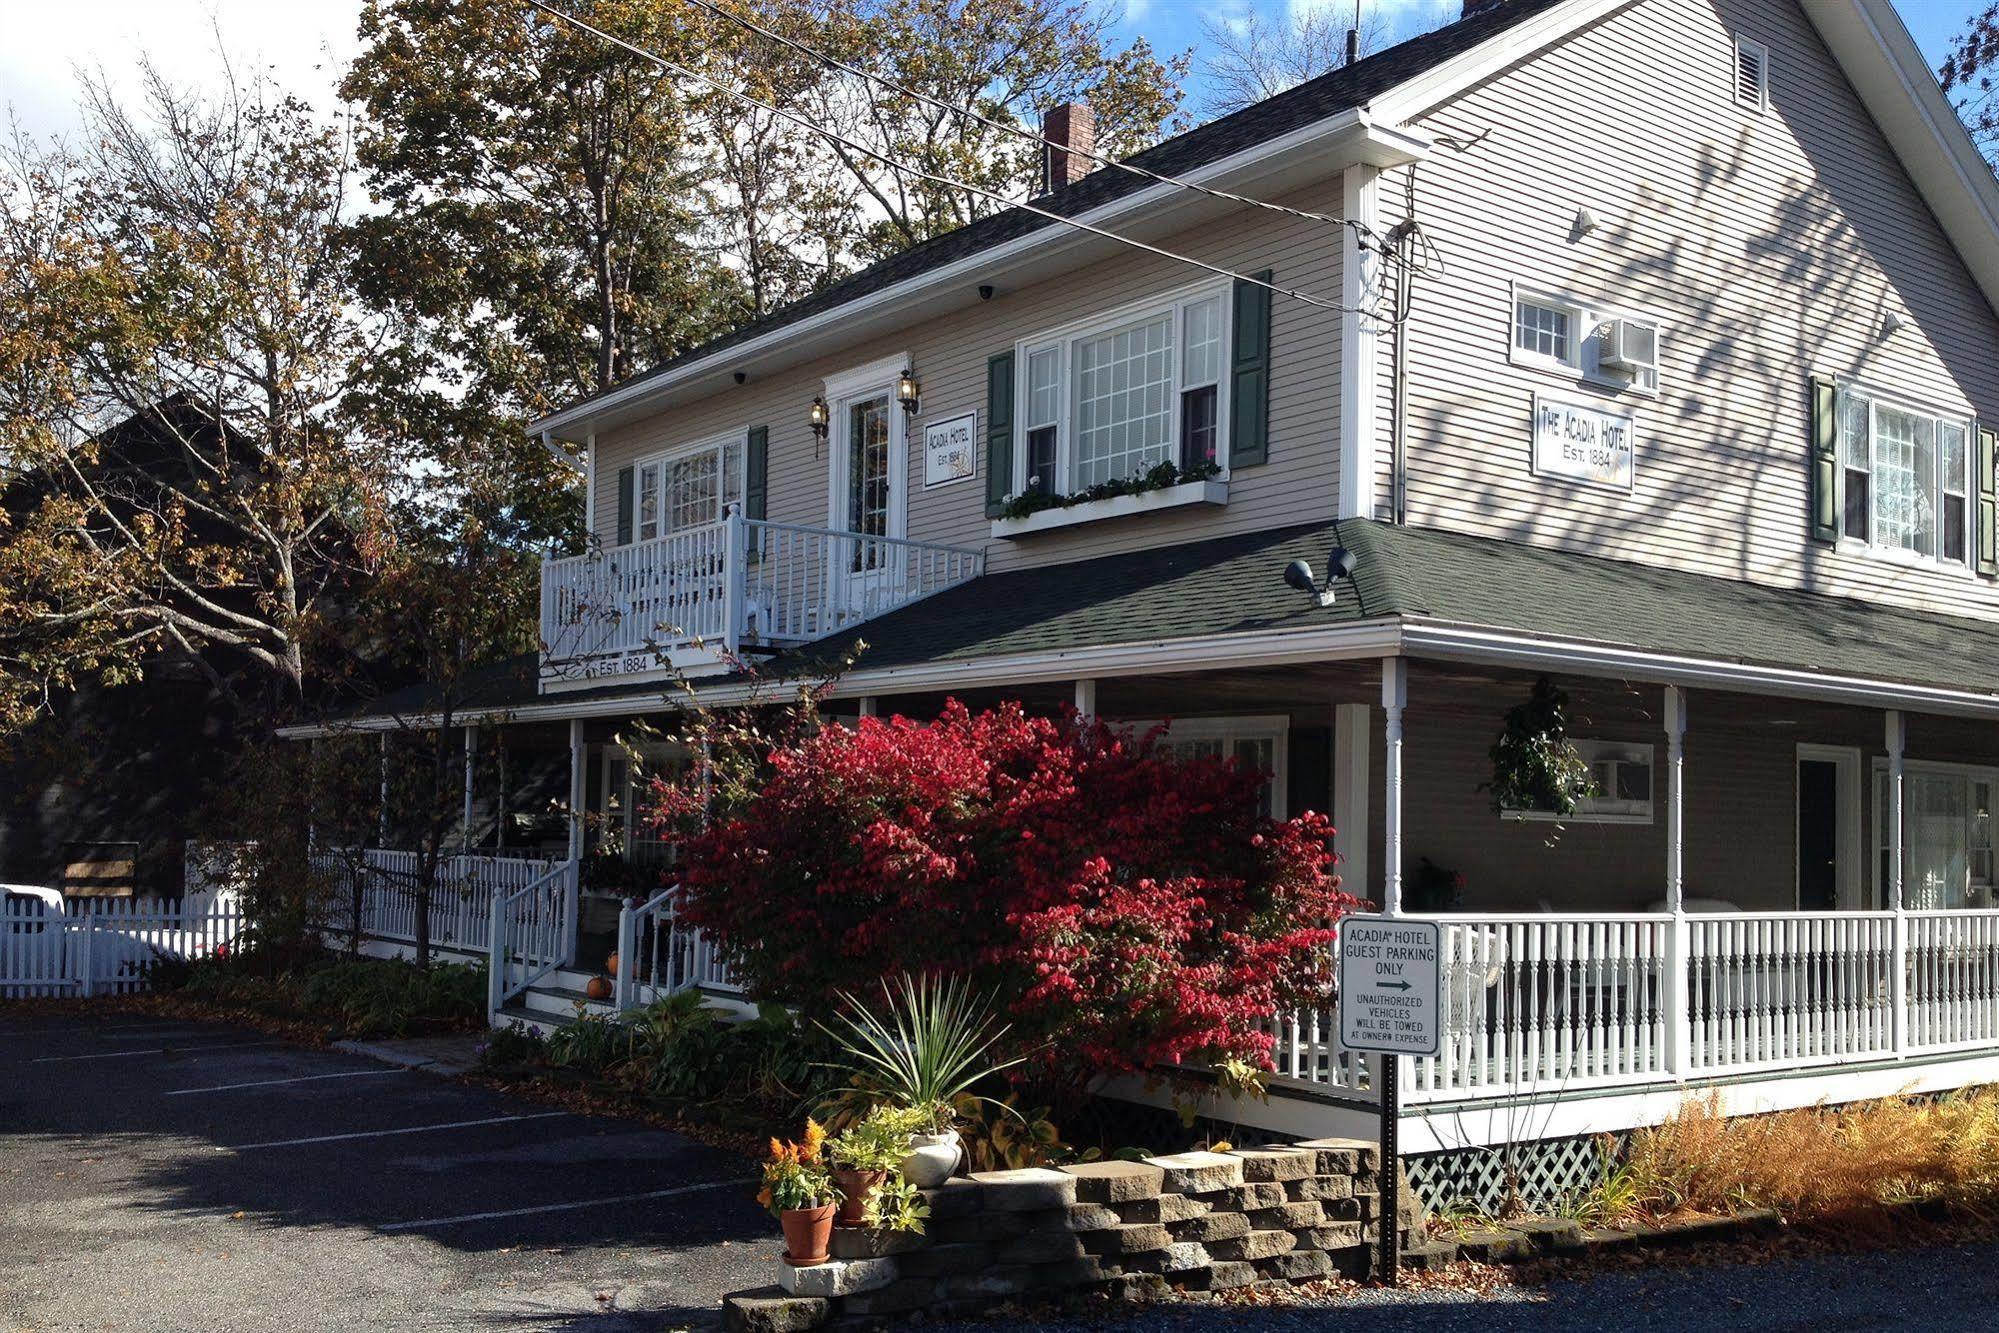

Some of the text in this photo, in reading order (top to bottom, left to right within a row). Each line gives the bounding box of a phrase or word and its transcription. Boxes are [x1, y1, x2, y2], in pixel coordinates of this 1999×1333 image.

[1542, 405, 1629, 452] THE ACADIA HOTEL
[929, 426, 969, 451] ACADIA HOTEL
[1563, 444, 1610, 468] EST. 1884
[600, 656, 647, 675] EST. 1884
[1394, 931, 1431, 945] HOTEL
[1346, 944, 1434, 961] GUEST PARKING
[1375, 962, 1404, 975] ONLY
[1356, 994, 1423, 1007] UNAUTHORIZED
[1368, 1008, 1410, 1020] VEHICLES
[1356, 1018, 1423, 1032] WILL BE TOWED
[1351, 1031, 1359, 1039] AT
[1395, 1033, 1428, 1044] EXPENSE
